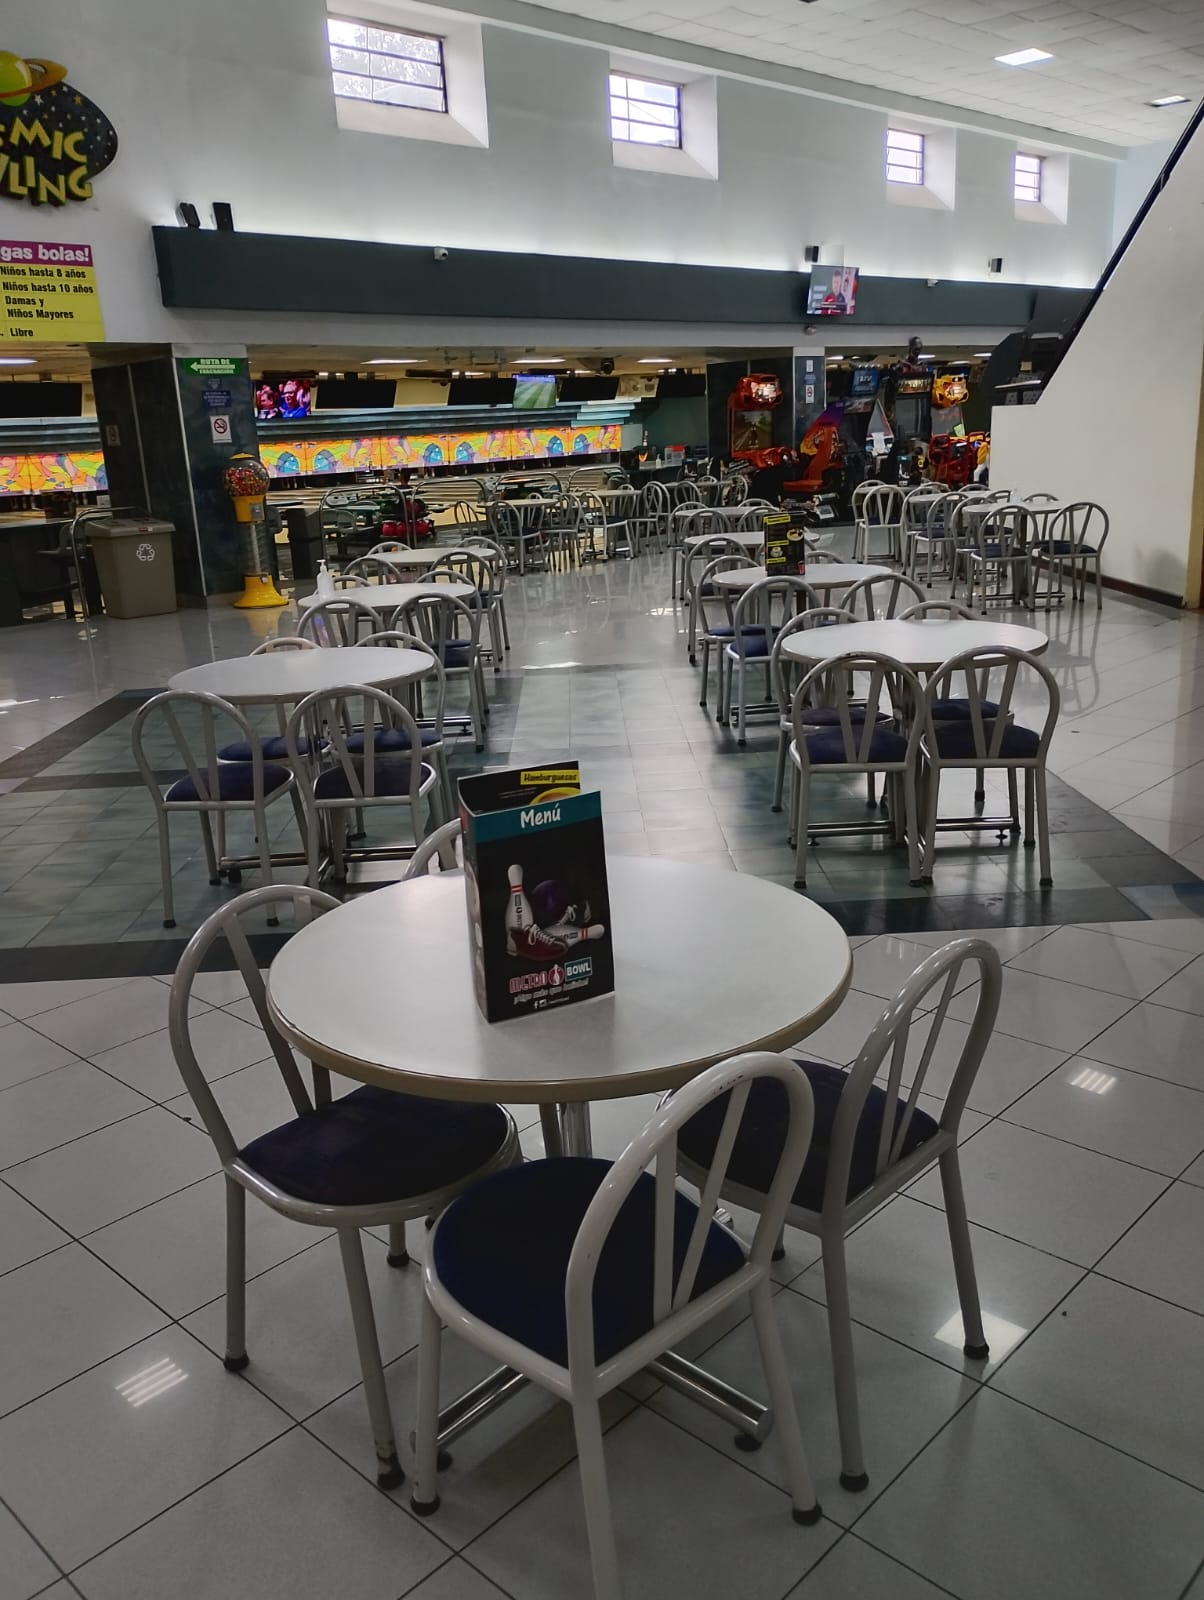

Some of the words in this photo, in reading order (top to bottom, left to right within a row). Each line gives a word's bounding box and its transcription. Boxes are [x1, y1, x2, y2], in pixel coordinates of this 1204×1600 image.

[38, 244, 89, 262] bolas!
[0, 266, 27, 276] Niños
[29, 267, 54, 277] hasta
[57, 269, 62, 277] 8
[65, 268, 86, 278] años
[3, 281, 28, 291] Niños
[31, 282, 56, 292] hasta
[60, 284, 70, 293] 10
[73, 283, 93, 293] años
[5, 296, 36, 305] Damas
[39, 298, 44, 307] y
[7, 308, 33, 318] Niños
[36, 309, 74, 320] Mayores
[10, 328, 33, 337] Libre
[520, 802, 561, 829] Menú
[566, 962, 592, 976] BOWL
